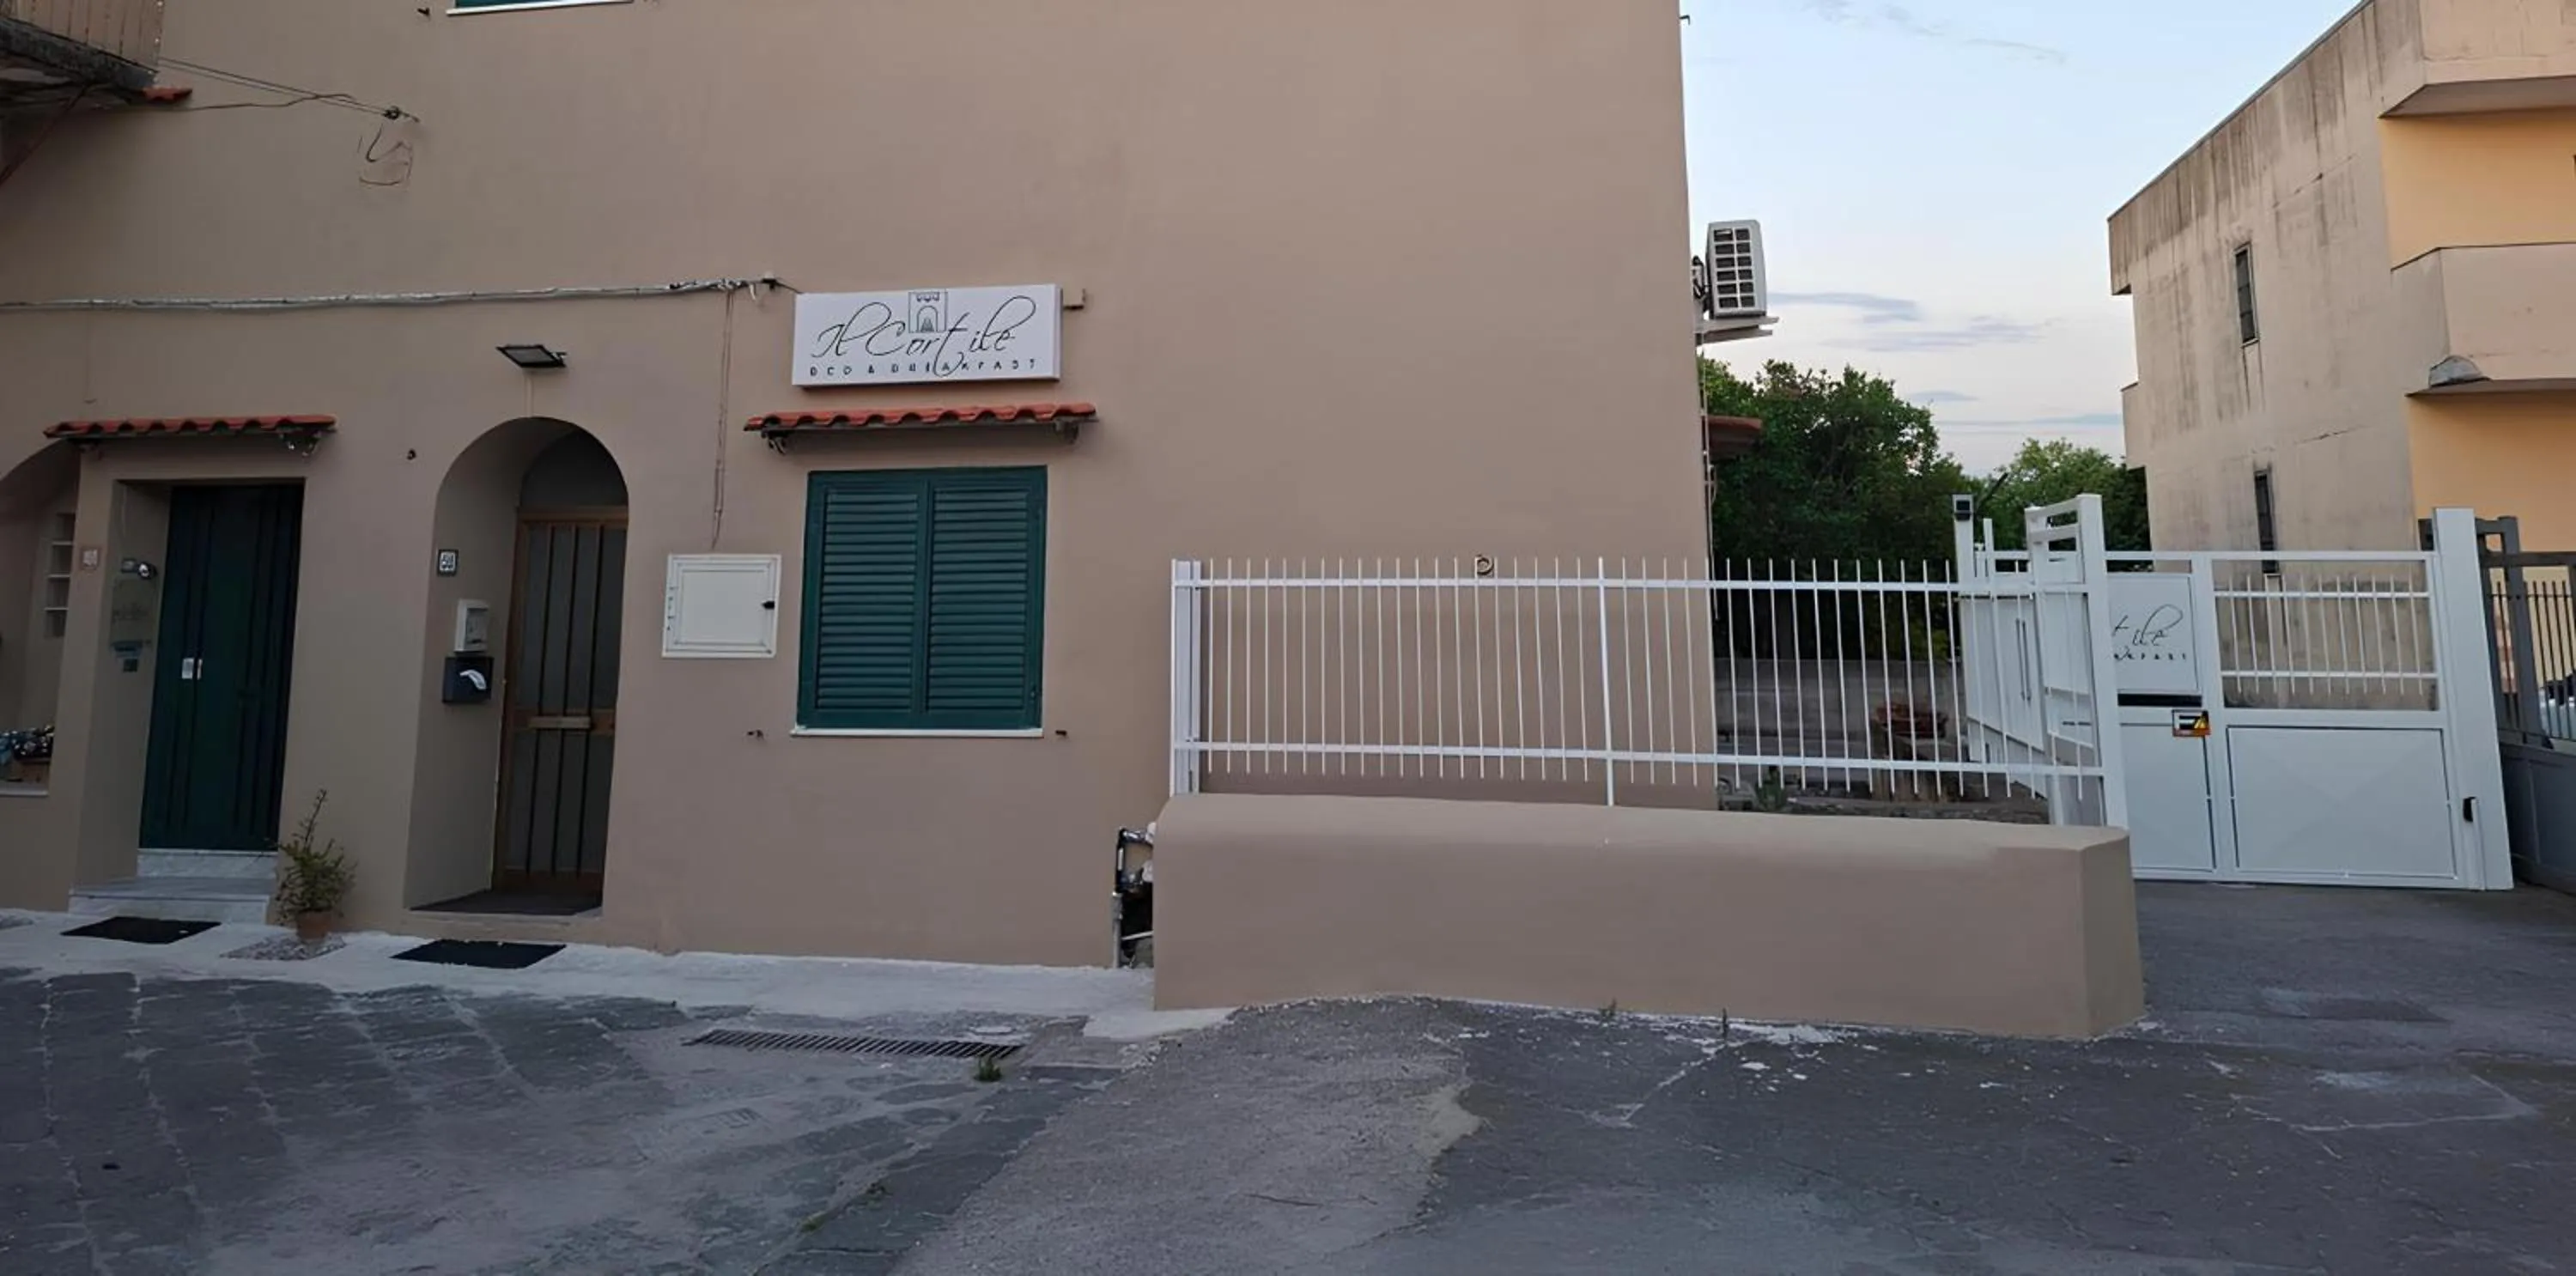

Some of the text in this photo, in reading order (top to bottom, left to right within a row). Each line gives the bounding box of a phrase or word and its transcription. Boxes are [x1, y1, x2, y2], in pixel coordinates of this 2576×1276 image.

[811, 295, 1036, 376] Il Cortile
[2112, 604, 2184, 650] tile
